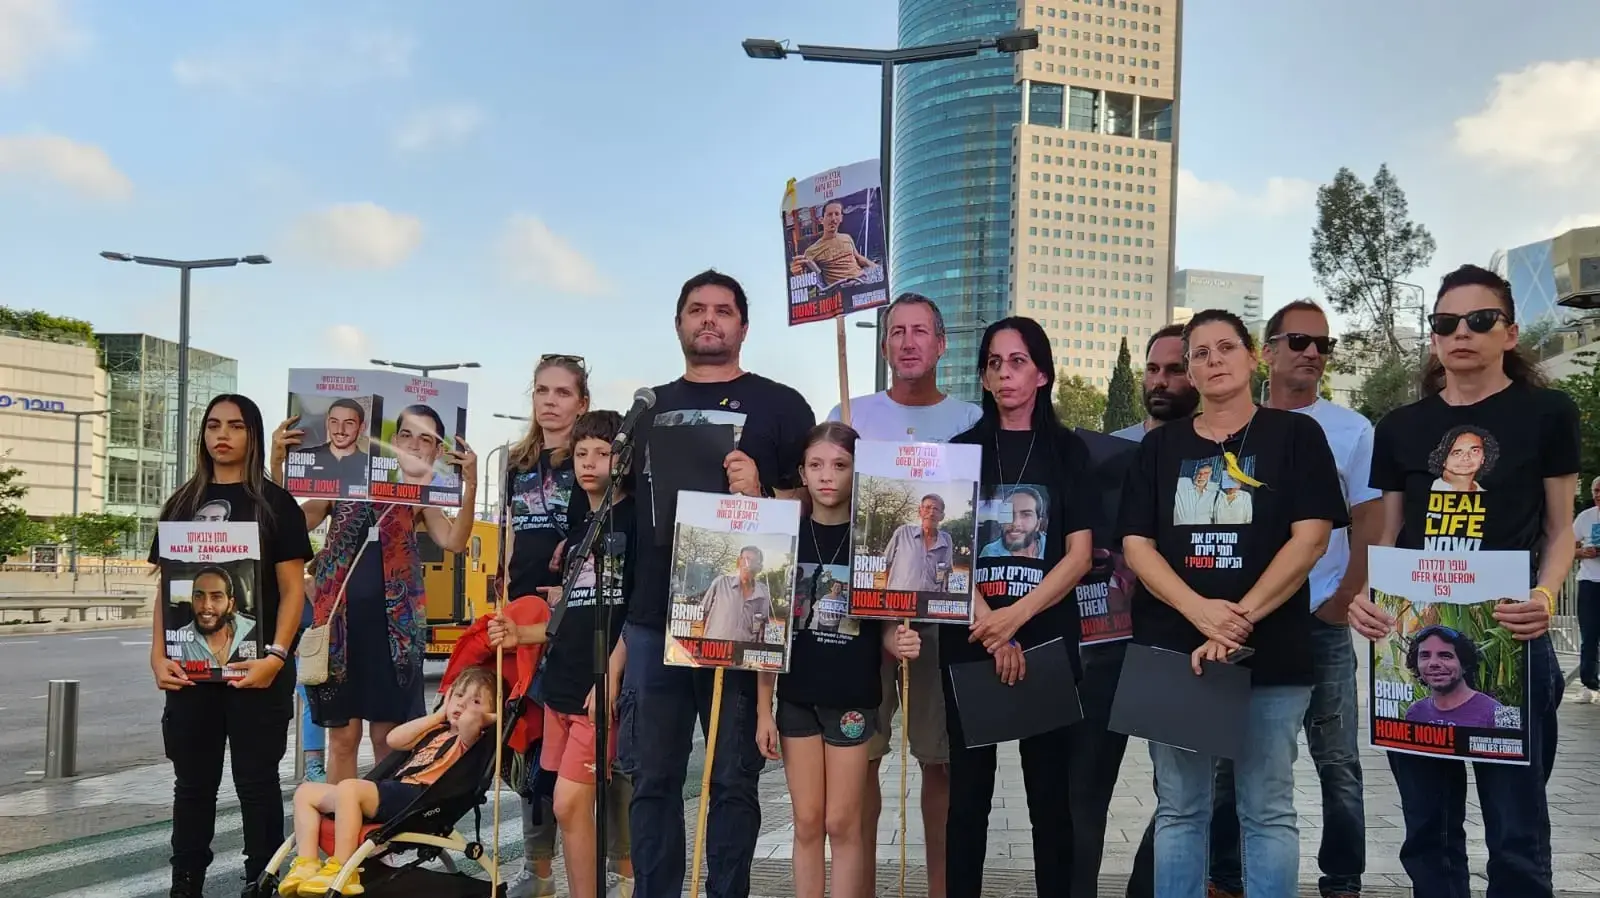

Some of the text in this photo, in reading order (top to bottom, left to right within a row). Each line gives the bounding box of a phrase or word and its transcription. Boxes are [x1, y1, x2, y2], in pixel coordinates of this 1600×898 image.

[790, 272, 817, 290] BRING
[791, 288, 809, 304] HIM
[792, 301, 818, 318] HOME
[820, 291, 843, 314] NOW!
[288, 452, 316, 466] BRING
[372, 457, 399, 470] BRING
[288, 465, 306, 478] HIM
[371, 468, 388, 482] HIM
[288, 478, 313, 492] HOME
[314, 479, 340, 493] NOW!
[371, 483, 395, 496] HOME
[397, 484, 421, 499] NOW!
[1428, 493, 1487, 513] DEAL
[1425, 514, 1485, 538] LIFE
[1190, 532, 1238, 544] מחזירים את
[170, 545, 249, 554] MATAN ZANGAUKER
[198, 553, 213, 561] (24)
[1216, 544, 1233, 556] תמי
[854, 555, 887, 572] BRING
[1215, 556, 1243, 568] הביתה
[1418, 559, 1468, 571] עופר קלדרון
[853, 571, 874, 588] HIM
[990, 565, 1005, 581] את
[1006, 565, 1044, 583] מחזירים
[1412, 570, 1476, 584] OFER KALDERON
[570, 589, 589, 599] now
[1076, 582, 1109, 601] BRING
[1434, 584, 1451, 596] (53)
[852, 591, 917, 610] HOME NOW!
[1077, 598, 1108, 617] THEM
[672, 603, 706, 620] BRING
[671, 620, 692, 637] HIM
[1081, 616, 1112, 635] HOME
[166, 629, 194, 642] BRING
[166, 644, 182, 657] HIM
[701, 641, 733, 659] NOW!
[1375, 679, 1414, 701] BRING
[1375, 698, 1399, 719] HIM
[1375, 718, 1455, 747] HOME NOW!
[1469, 742, 1523, 755] FAMILIES FORUM
